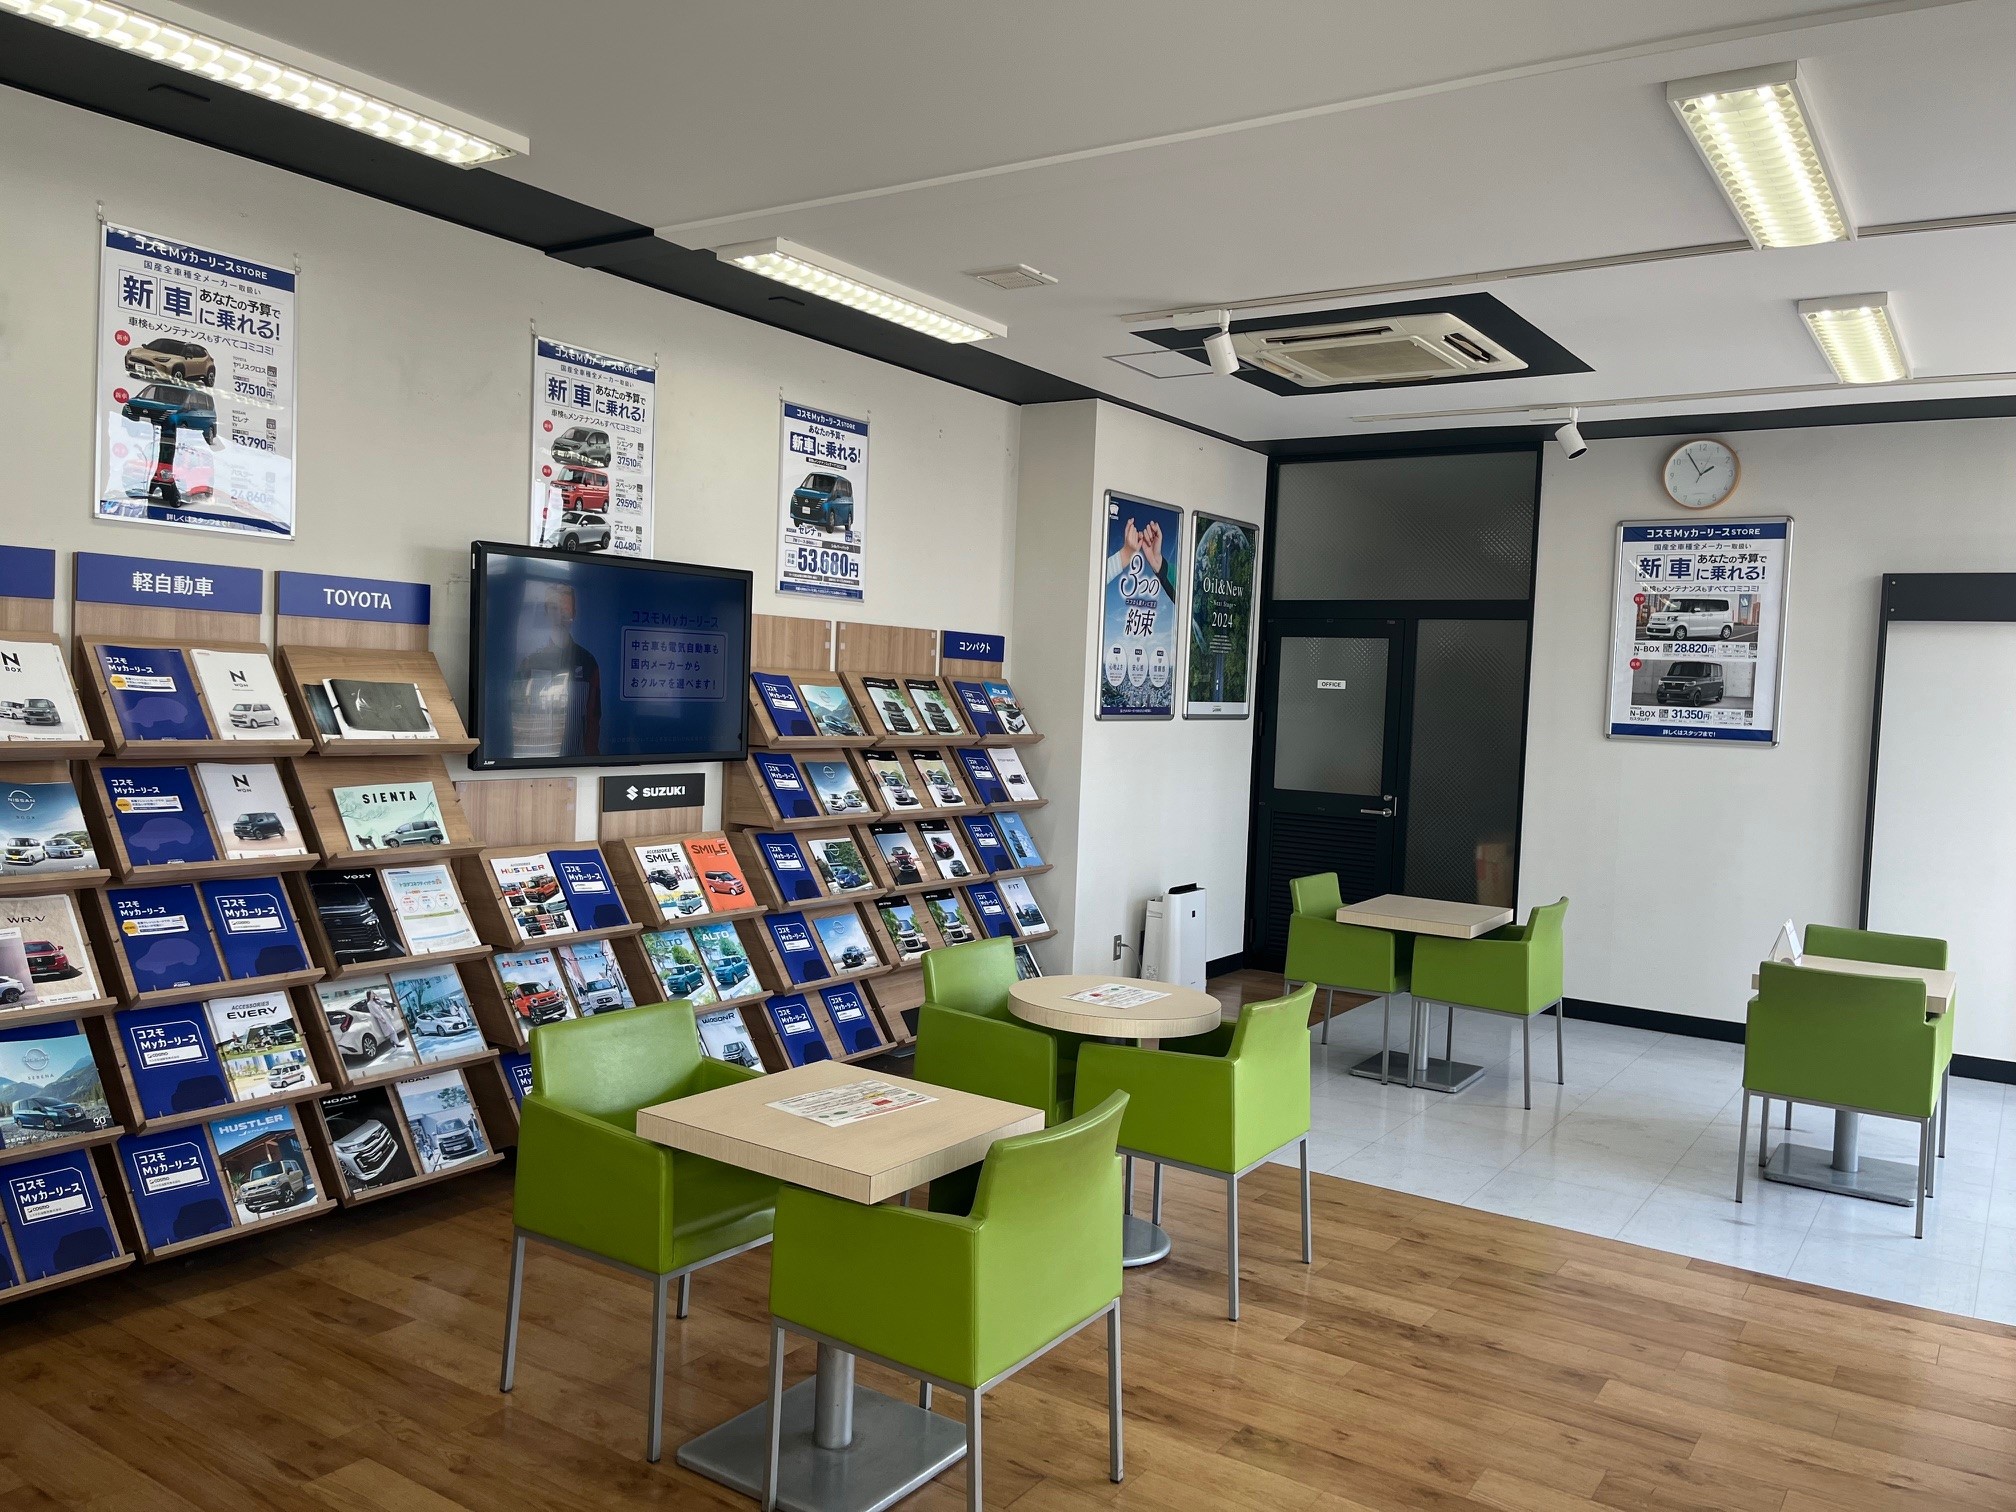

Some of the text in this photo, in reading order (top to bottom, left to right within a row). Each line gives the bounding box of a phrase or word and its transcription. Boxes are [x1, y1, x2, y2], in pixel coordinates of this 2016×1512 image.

[144, 260, 261, 295] 国産全車種全メーカー取扱い
[200, 288, 281, 320] あなたの予算で
[233, 362, 266, 374] ヤリスクロス
[596, 384, 646, 406] あなたの予算で
[232, 415, 249, 423] セレナ
[798, 526, 816, 536] セレナ
[1646, 528, 1760, 538] コスモMyカーリースSTORE
[1654, 543, 1752, 551] 国産全車種全メーカー取扱い
[1697, 553, 1767, 564] あなたの予算で
[132, 571, 214, 597] 軽自動車
[1203, 576, 1244, 597] Oil&New
[323, 588, 392, 610] TOYOTA
[632, 611, 718, 628] コスモMyカーリース
[1125, 608, 1155, 637] 約束
[1212, 612, 1233, 628] 2024
[632, 640, 719, 654] 中古車も電気自動車も
[959, 641, 991, 654] コンパクト
[1, 652, 20, 666] N
[106, 656, 128, 665] コスモ
[631, 658, 700, 671] 国内メーカーから
[108, 664, 154, 674] Myカーリース
[229, 670, 246, 683] N
[631, 678, 716, 690] おクルマを選べます!
[232, 775, 249, 788] N
[362, 790, 417, 804] SIENTA
[642, 786, 686, 797] SUZUKI
[691, 843, 729, 856] SMILE
[646, 852, 680, 863] SMILE
[500, 864, 546, 874] HUSTLER
[118, 900, 140, 908] コスモ
[222, 898, 247, 908] コスモ
[120, 906, 166, 916] Myカーリース
[224, 906, 277, 918] Myカーリース
[7, 916, 46, 924] WR-V
[702, 930, 730, 941] ALTO
[656, 938, 682, 948] ALTO
[502, 956, 550, 968] HUSTLER
[232, 1001, 270, 1010] ACCESSORIES
[226, 1006, 278, 1020] EVERY
[136, 1028, 165, 1040] コスモ
[140, 1034, 198, 1050] Myカーリース
[400, 1076, 430, 1084] NOAH
[322, 1094, 357, 1105] NOAH
[219, 1114, 284, 1134] HUSTLER
[139, 1152, 166, 1164] コスモ
[142, 1156, 199, 1176] Myカーリース
[16, 1178, 46, 1192] コスモ
[20, 1182, 82, 1204] Myカーリース
